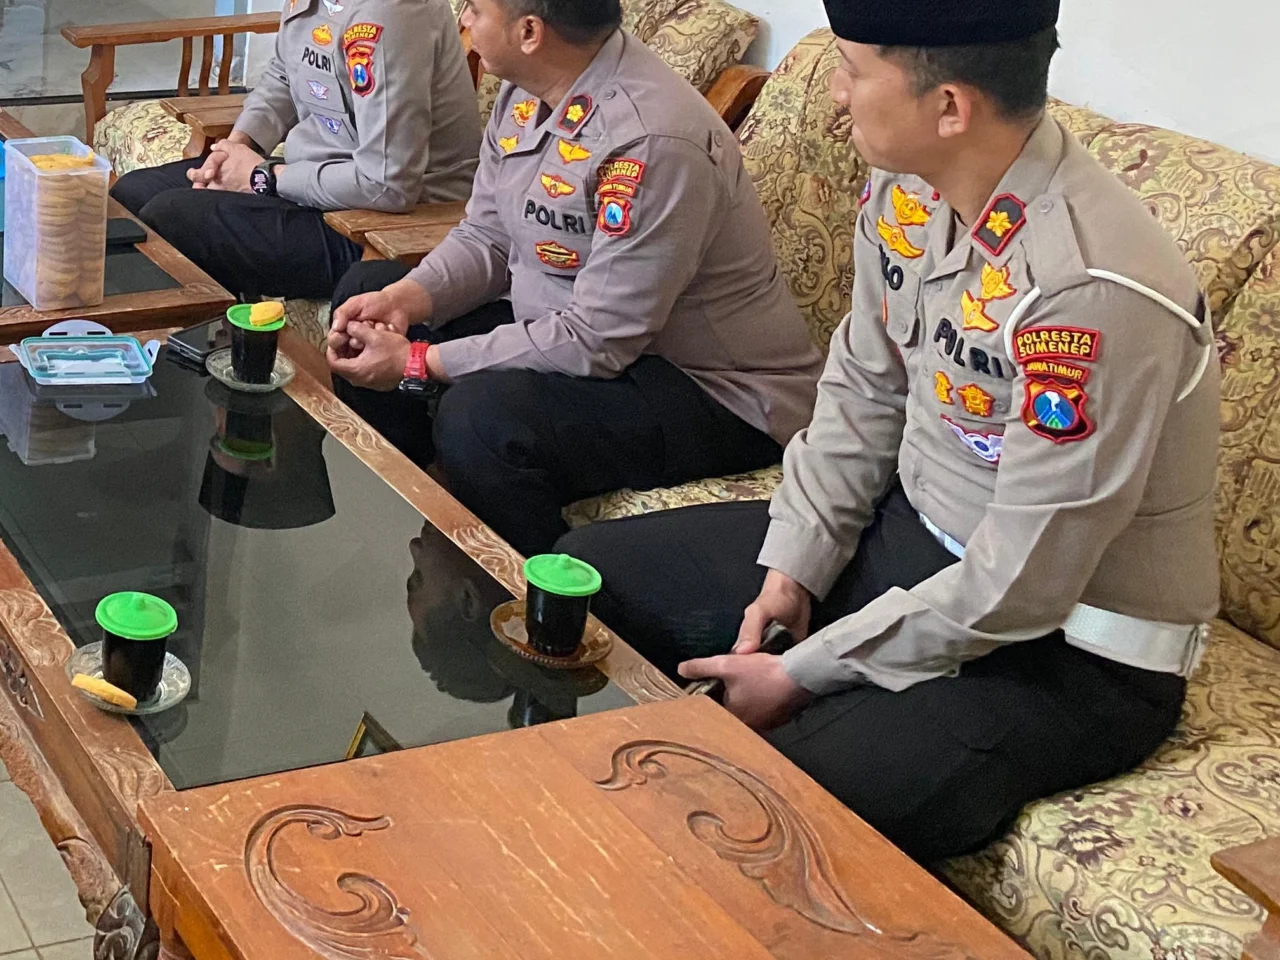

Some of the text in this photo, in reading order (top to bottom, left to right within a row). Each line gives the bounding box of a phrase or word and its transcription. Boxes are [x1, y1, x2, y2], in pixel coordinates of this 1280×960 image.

[301, 46, 332, 73] POLRI
[523, 199, 585, 234] POLRI
[933, 317, 1004, 379] POLRI
[1017, 331, 1092, 349] POLRESTA
[1019, 341, 1091, 357] SUMENEP
